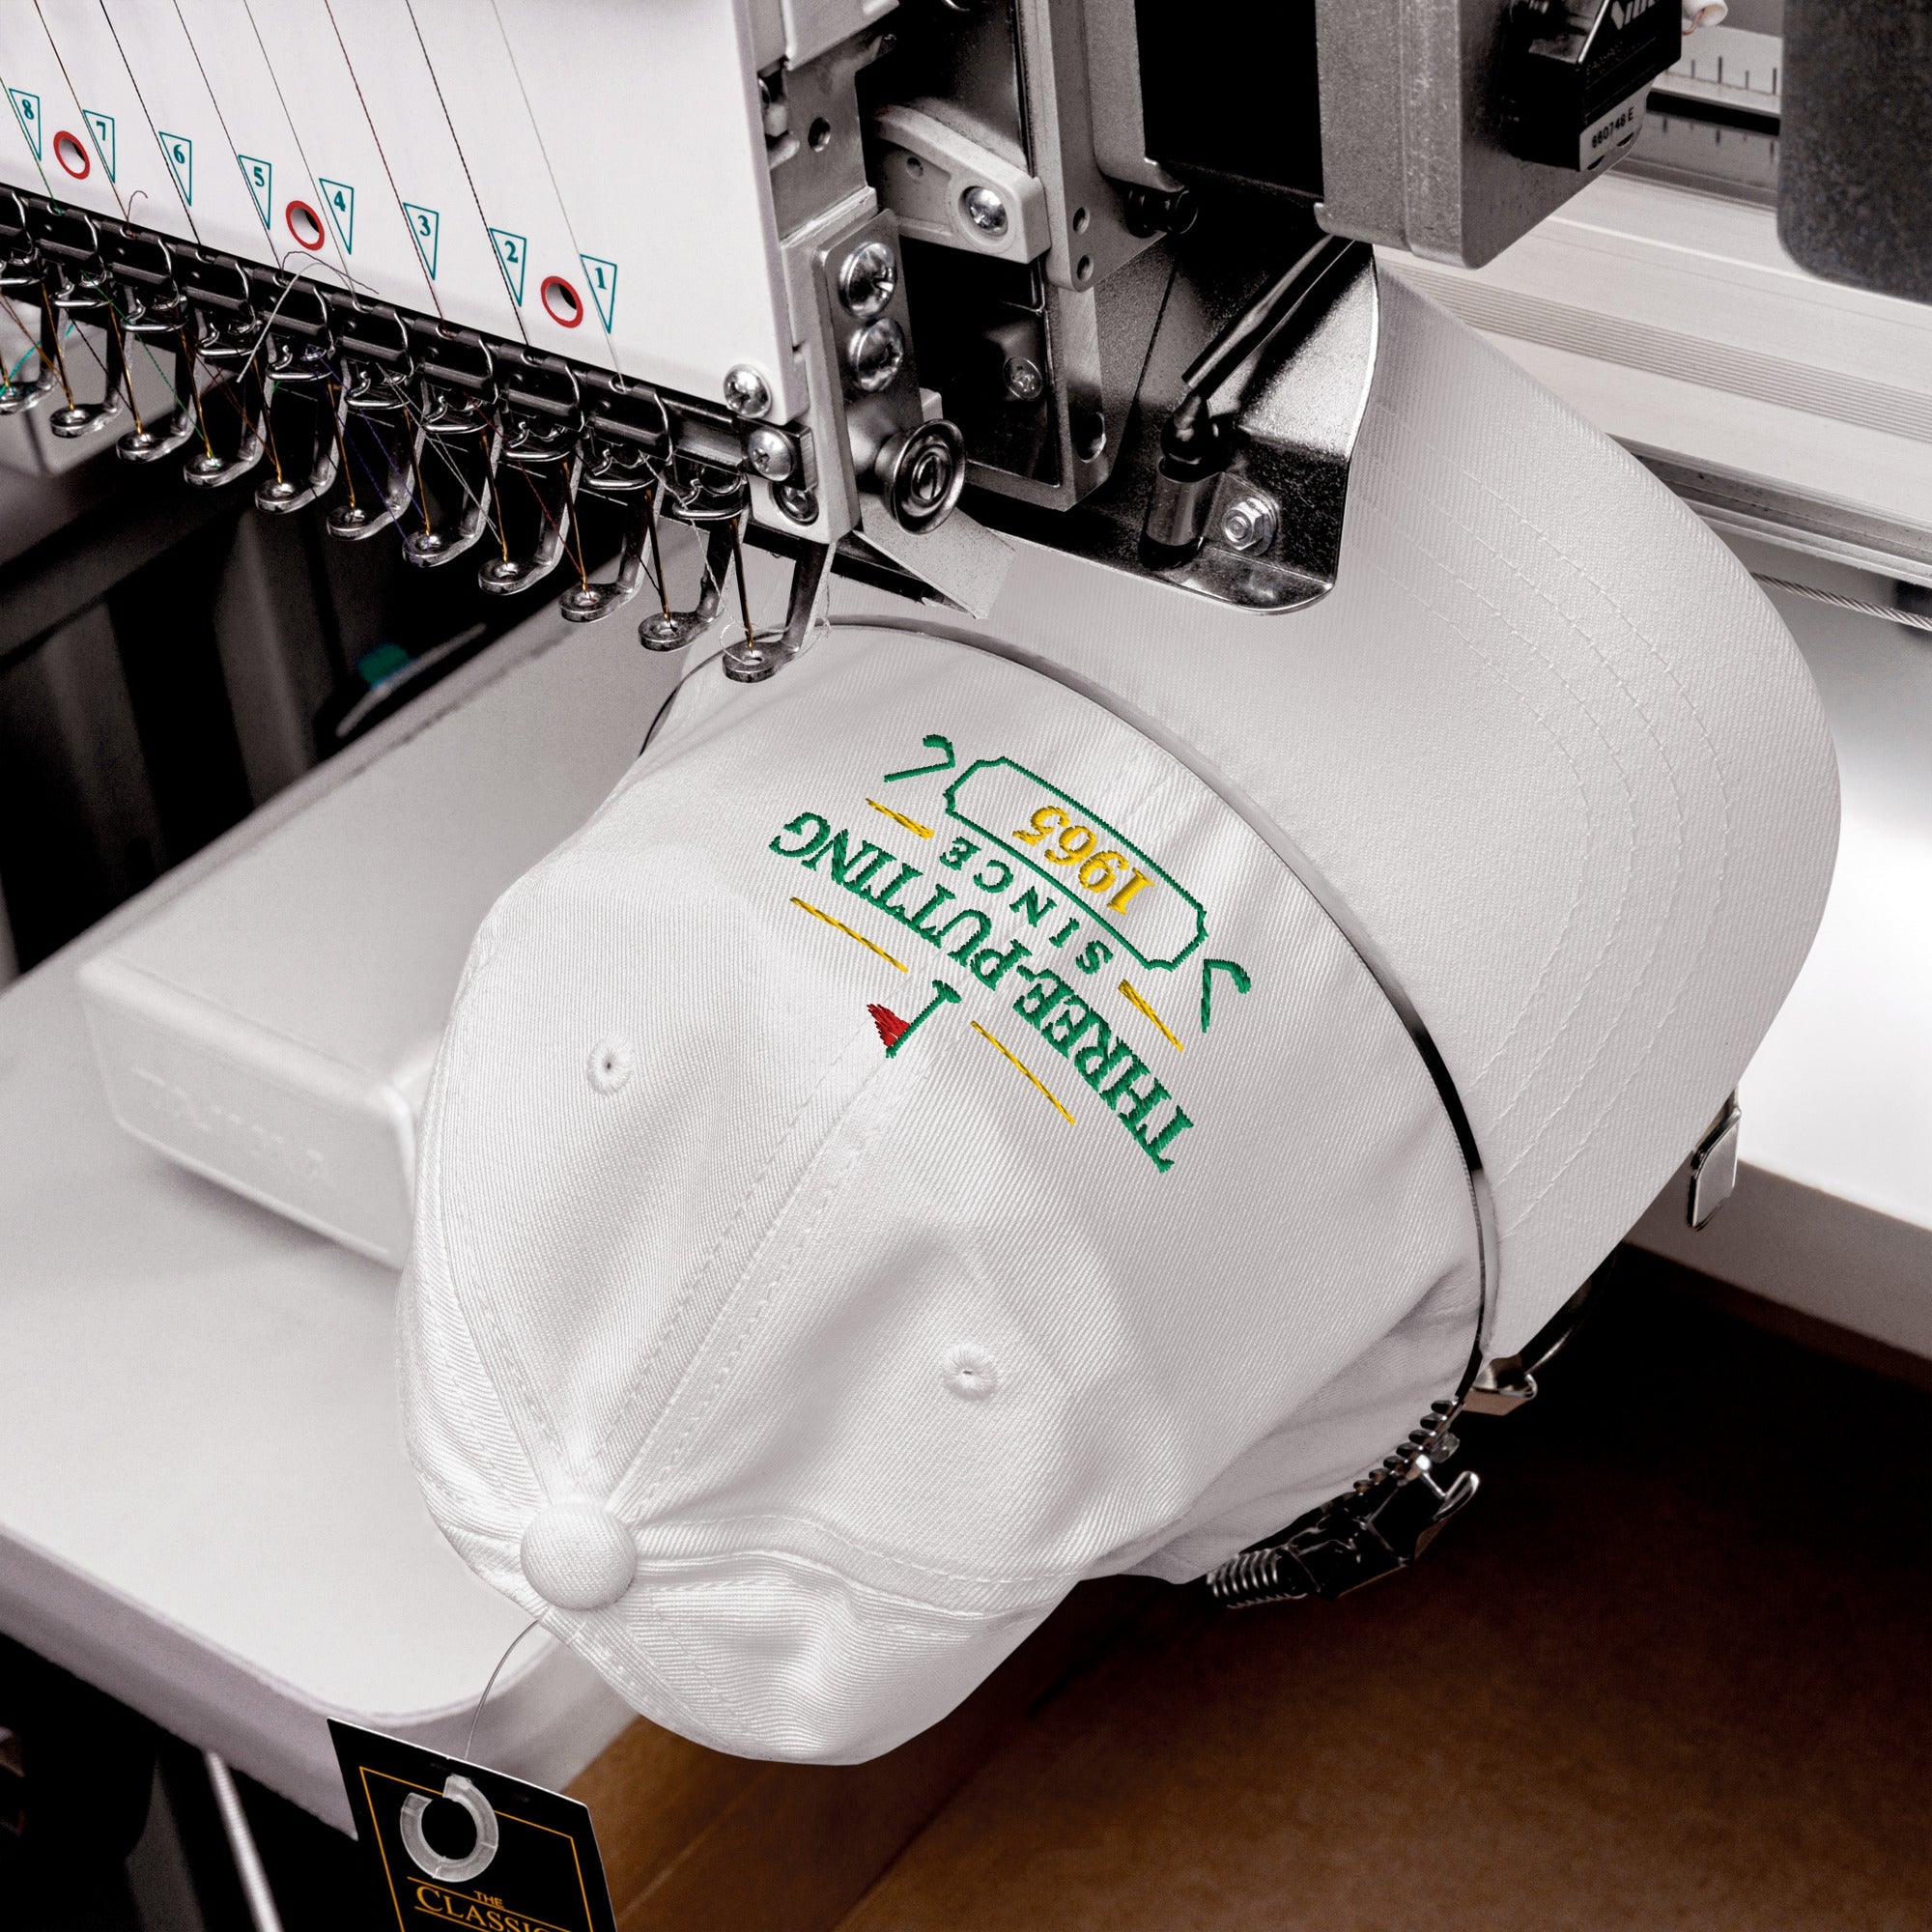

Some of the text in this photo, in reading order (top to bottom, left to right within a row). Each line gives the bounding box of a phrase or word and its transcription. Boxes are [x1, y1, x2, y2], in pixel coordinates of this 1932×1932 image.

[21, 99, 35, 121] 8
[96, 120, 106, 141] 7
[173, 144, 185, 164] 6
[253, 166, 265, 187] 5
[333, 190, 346, 212] 4
[417, 214, 431, 237] 3
[504, 241, 519, 264] 2
[594, 267, 607, 290] 1
[1012, 806, 1154, 915] 1965
[940, 837, 1113, 974] SINCE
[769, 812, 1194, 1173] THREE-PUTTING
[415, 1886, 550, 1932] CLASSI
[473, 1889, 504, 1909] THE
